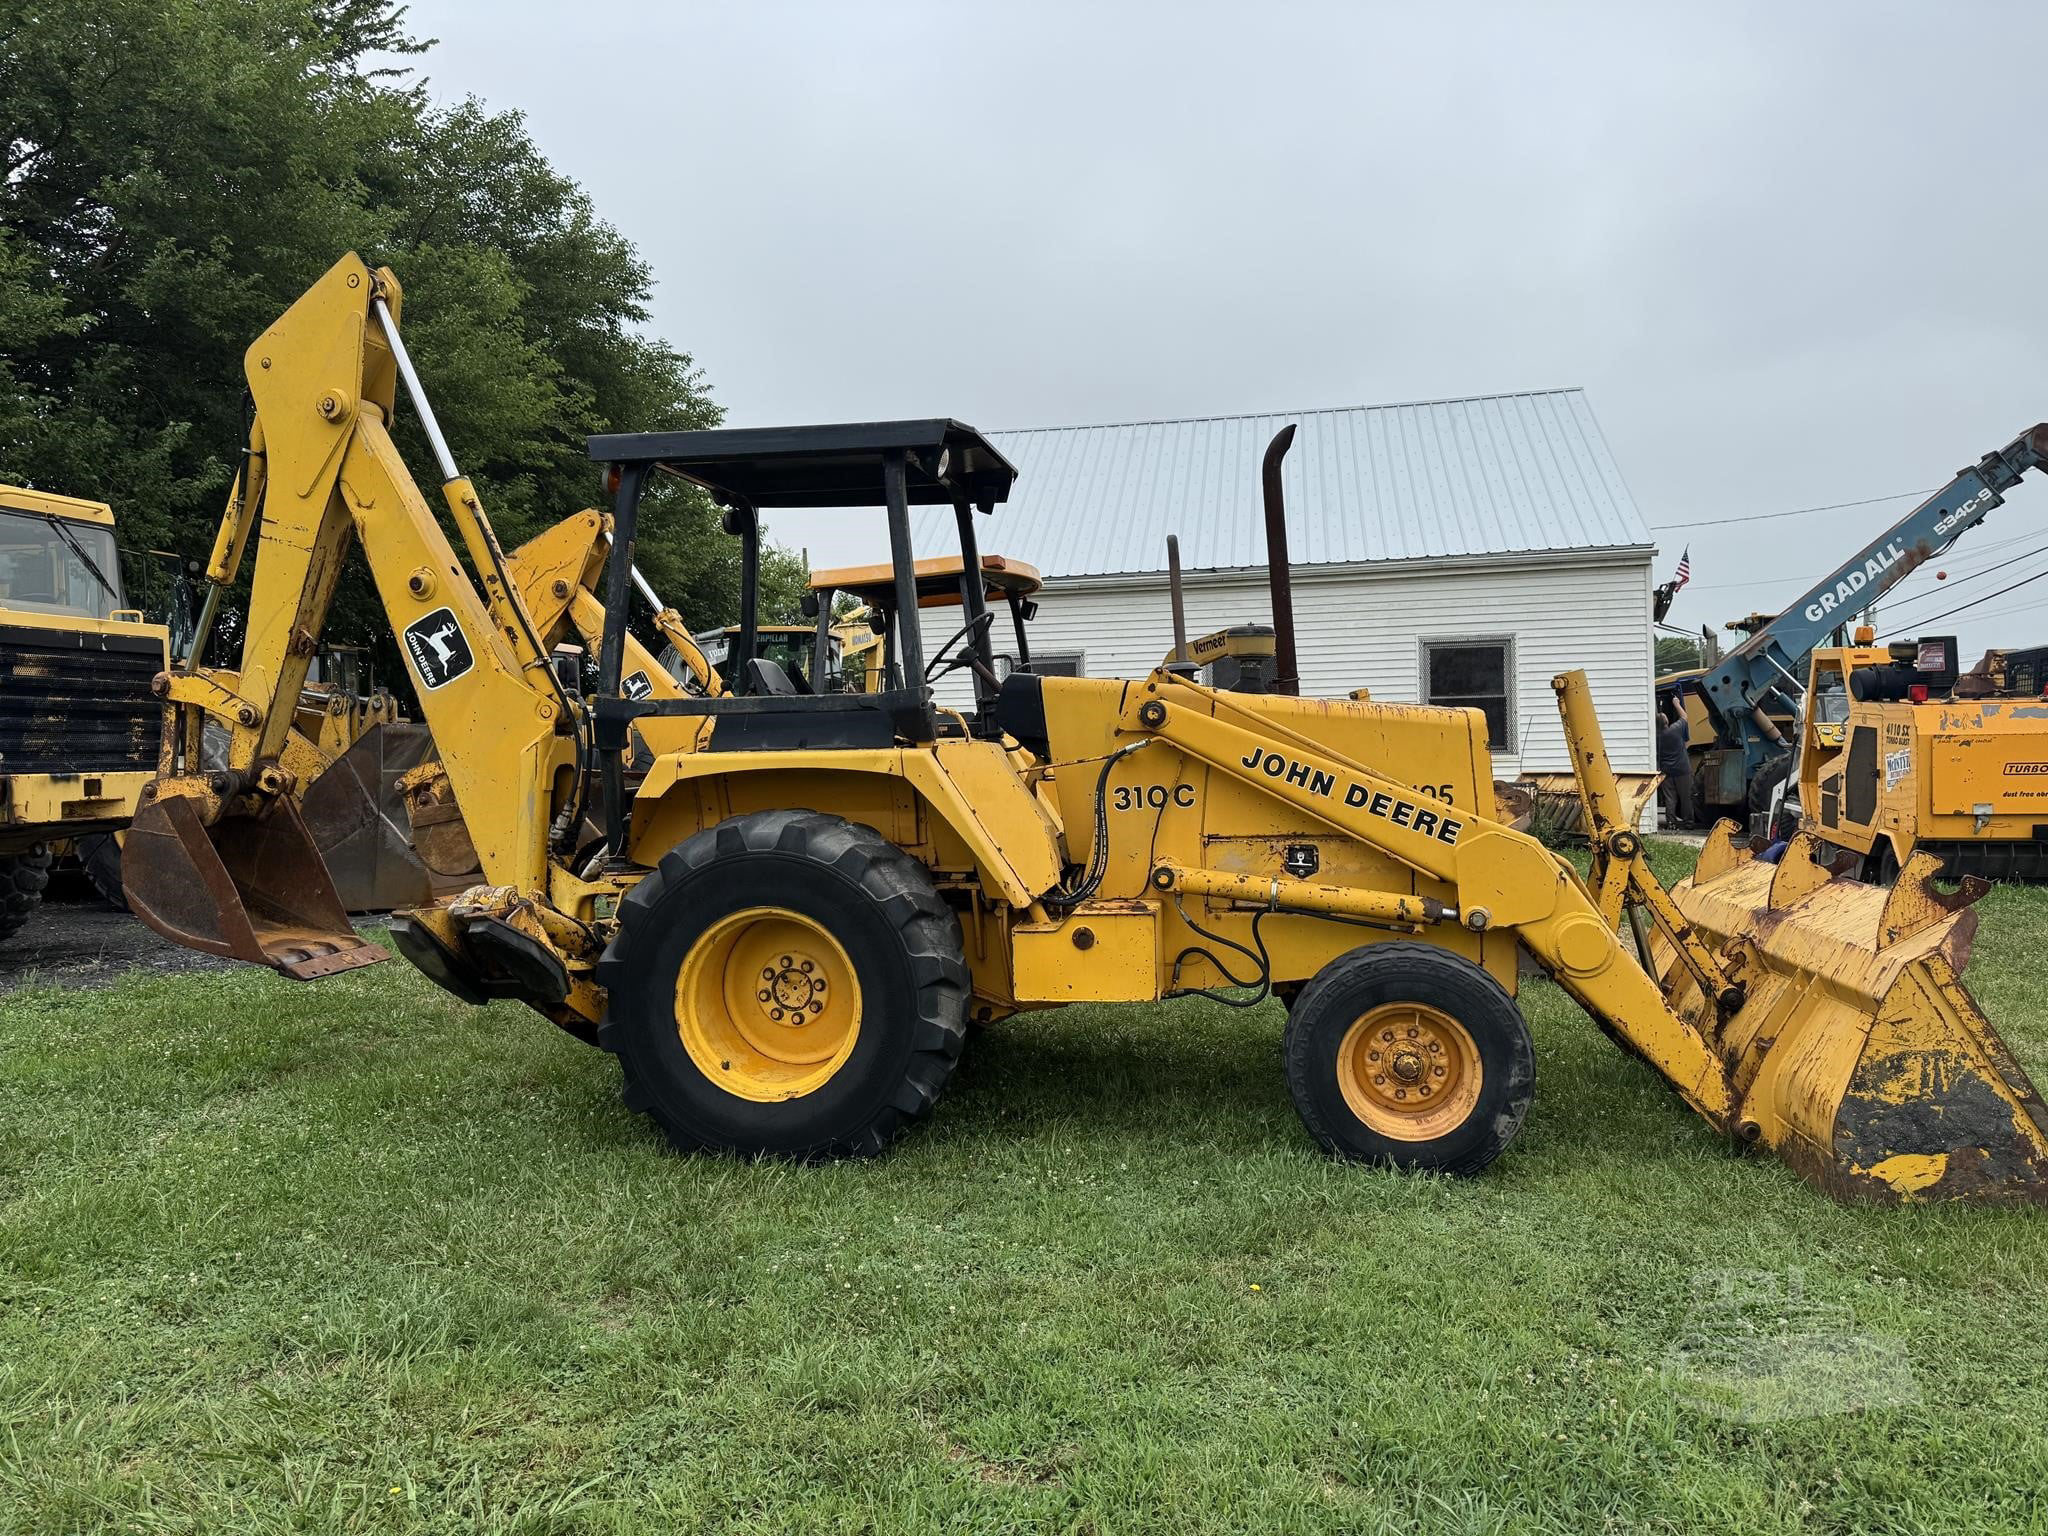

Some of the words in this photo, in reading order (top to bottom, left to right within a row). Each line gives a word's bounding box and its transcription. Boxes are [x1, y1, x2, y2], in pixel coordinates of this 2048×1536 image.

[1933, 488, 1992, 535] 534C-9
[1805, 541, 1905, 622] GRADALL
[757, 634, 788, 642] ERPILLAR
[1193, 635, 1226, 654] Vermeer
[407, 632, 422, 656] JOHN
[418, 655, 437, 686] DEERE
[708, 647, 728, 658] VOLV
[1886, 723, 1900, 736] 4110
[1901, 724, 1910, 737] SX
[2008, 765, 2048, 773] TURBO
[1114, 784, 1195, 811] 310C
[1241, 746, 1336, 798] JOHN
[1343, 782, 1464, 846] DEERE
